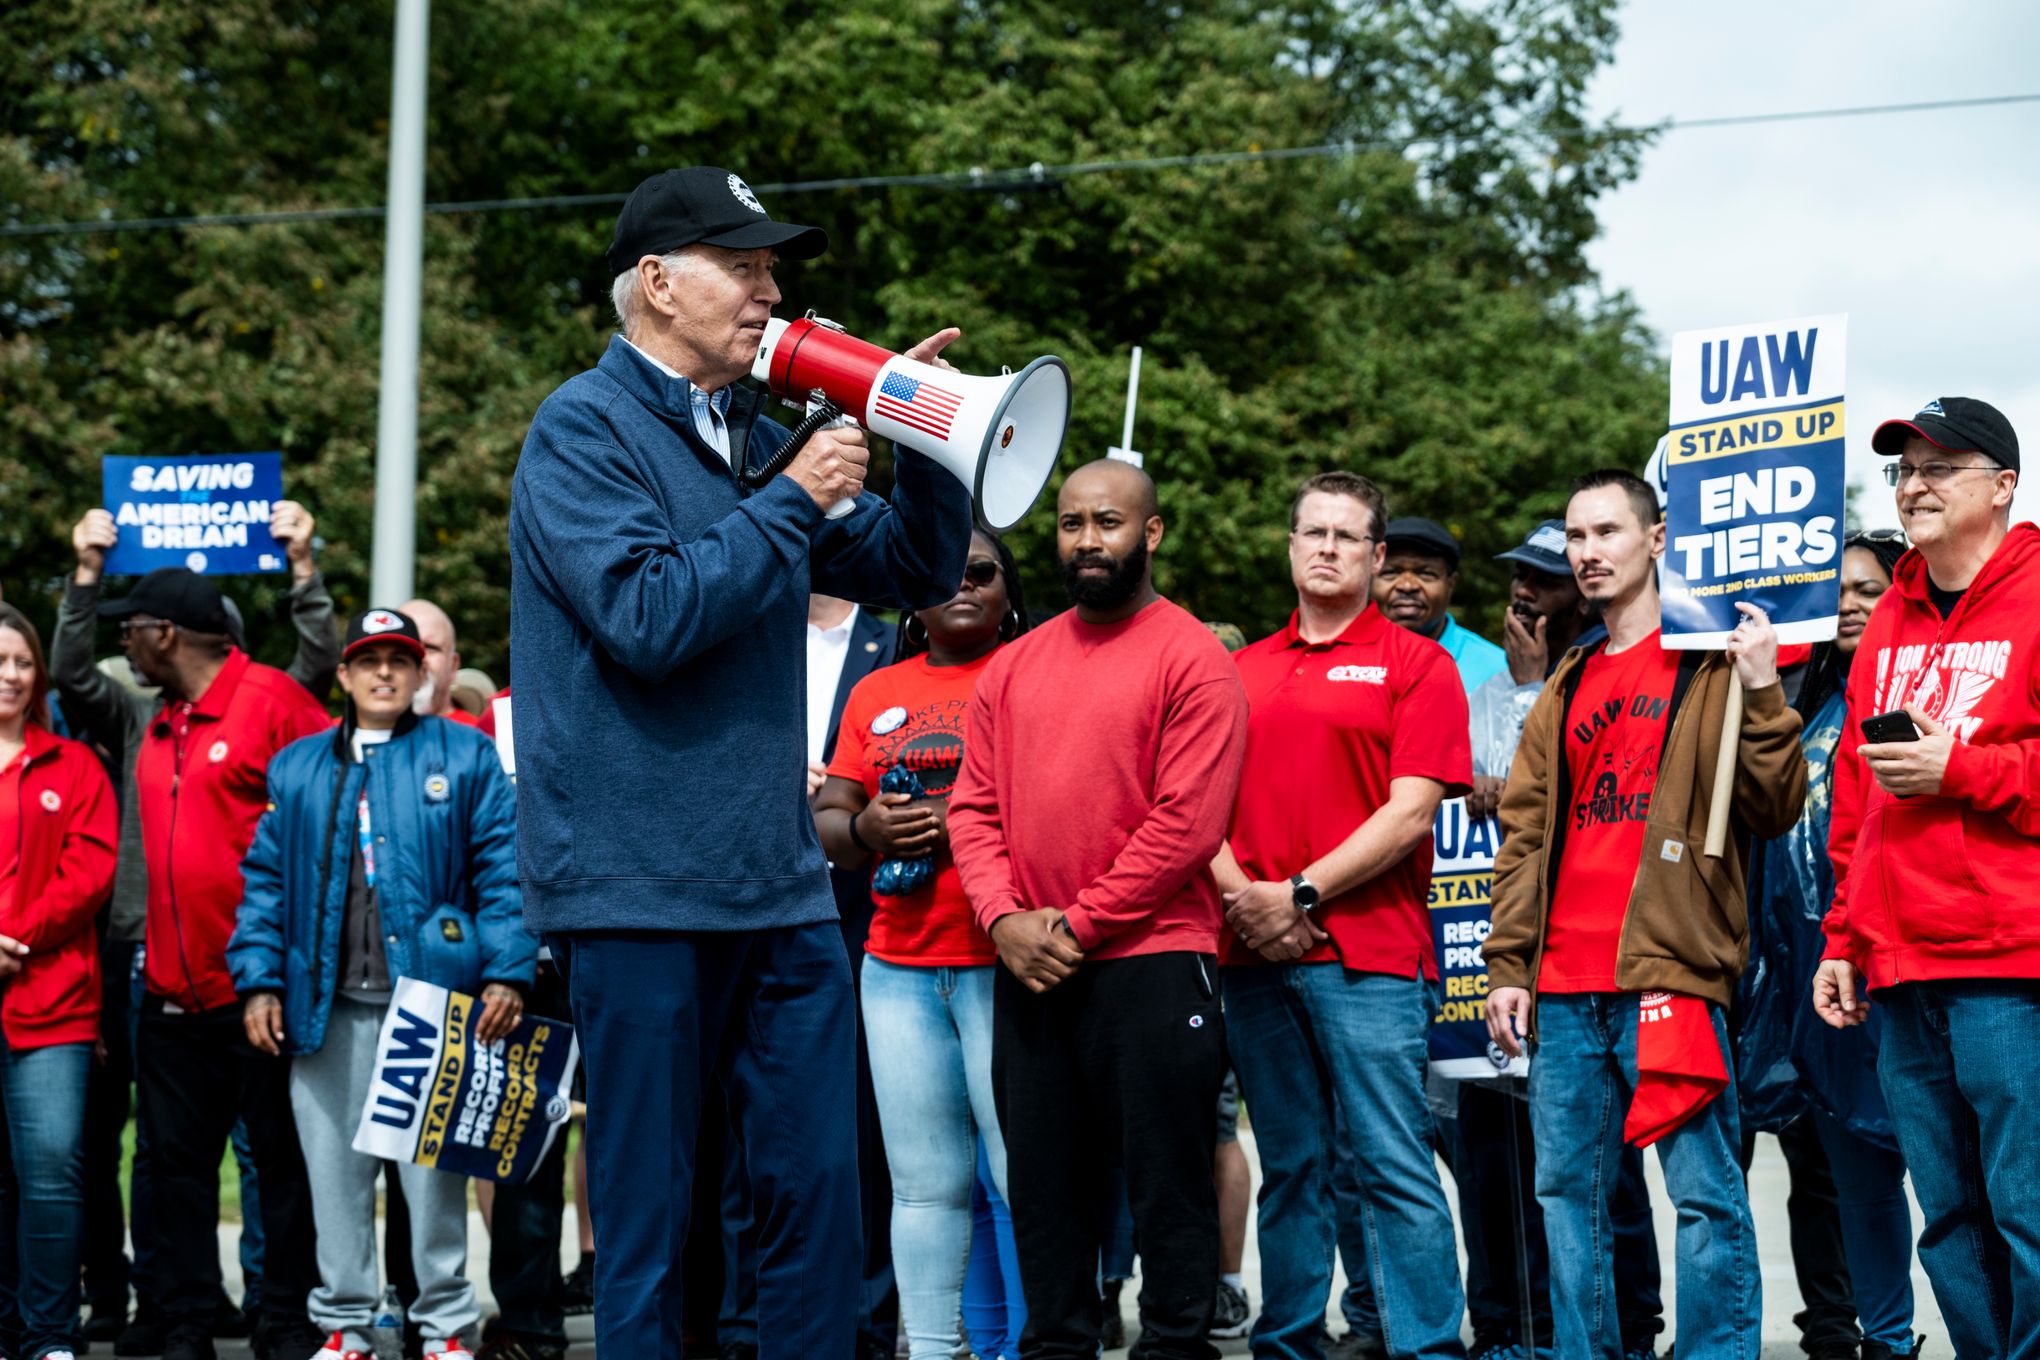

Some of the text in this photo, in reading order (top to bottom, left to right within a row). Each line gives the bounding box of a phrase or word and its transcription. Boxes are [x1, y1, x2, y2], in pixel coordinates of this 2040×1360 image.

[1701, 327, 1818, 405] UAW
[1679, 411, 1835, 457] STAND UP
[130, 462, 254, 492] SAVING
[1700, 466, 1816, 525] END
[116, 499, 270, 526] AMERICAN
[142, 523, 248, 549] DREAM
[1674, 515, 1837, 580] TIERS
[1691, 583, 1724, 597] MORE
[1726, 580, 1743, 594] 2ND
[1744, 575, 1781, 590] CLASS
[1783, 568, 1837, 585] WORKERS
[1573, 694, 1668, 745] UAW ON
[904, 745, 960, 771] UAW
[1576, 793, 1650, 831] STRIKE
[1427, 878, 1491, 904] STAN
[1446, 973, 1489, 998] REC
[370, 1007, 438, 1130] UAW
[423, 1004, 464, 1157] STAND UP
[470, 1038, 505, 1148] PROFITS
[488, 1043, 524, 1151] RECORD
[497, 1025, 550, 1178] CONTRACTS
